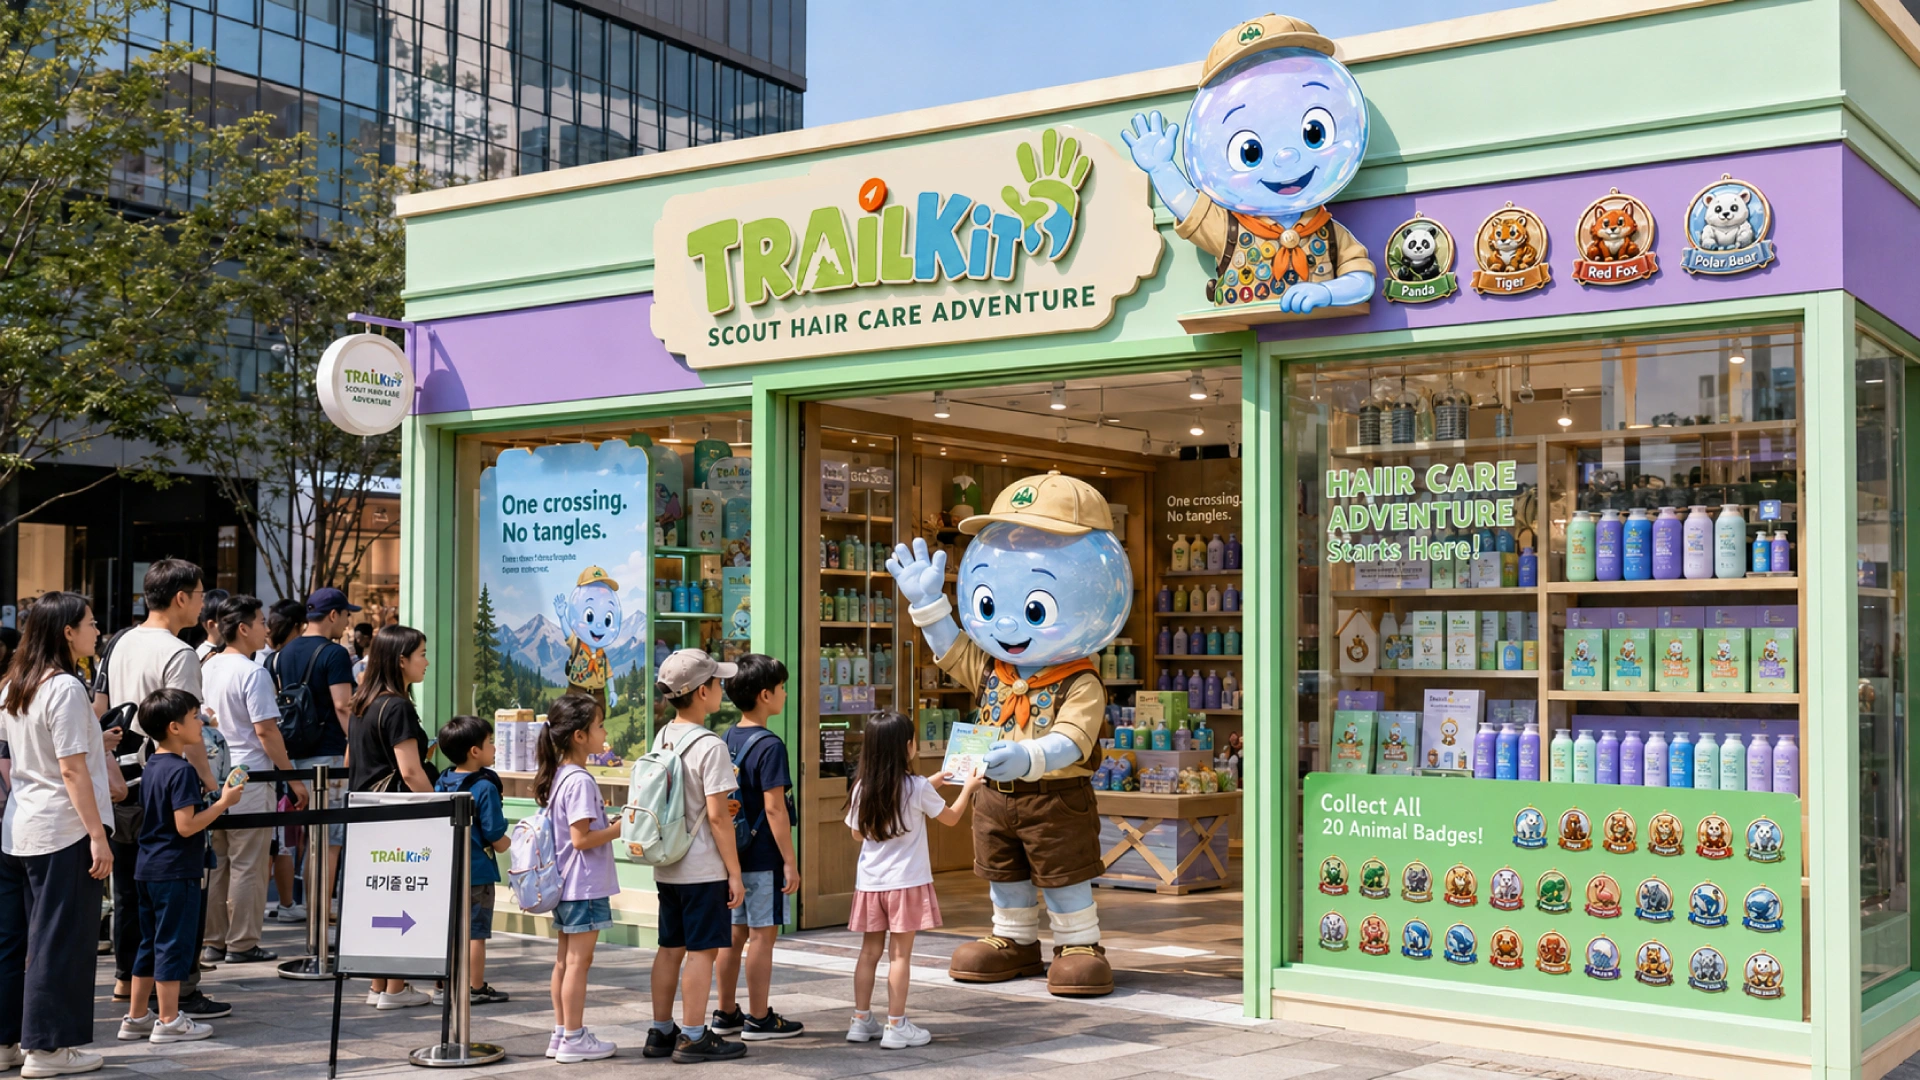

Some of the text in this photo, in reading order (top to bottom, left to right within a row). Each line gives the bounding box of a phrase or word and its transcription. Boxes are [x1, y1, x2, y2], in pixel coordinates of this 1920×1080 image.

[1694, 252, 1758, 269] Polar Bear
[1588, 263, 1639, 280] Red Fox
[1401, 284, 1435, 298] Panda
[1494, 275, 1525, 291] Tiger
[707, 285, 1096, 348] SCOUT HAIR CARE ADVENTURE
[345, 385, 366, 394] SCOUT
[352, 395, 392, 406] ADVENTURE
[1425, 460, 1518, 494] CARE
[502, 489, 627, 515] One crossing.
[1167, 492, 1243, 507] One crossing.
[1167, 508, 1232, 524] No tangles.
[1327, 498, 1516, 534] ADVENTURE
[502, 518, 607, 546] No tangles.
[1327, 534, 1481, 563] Starts Here!
[1321, 793, 1422, 817] Collect All
[1322, 818, 1484, 847] 20 Animal Badges!
[366, 874, 429, 891] 대기줄 입구
